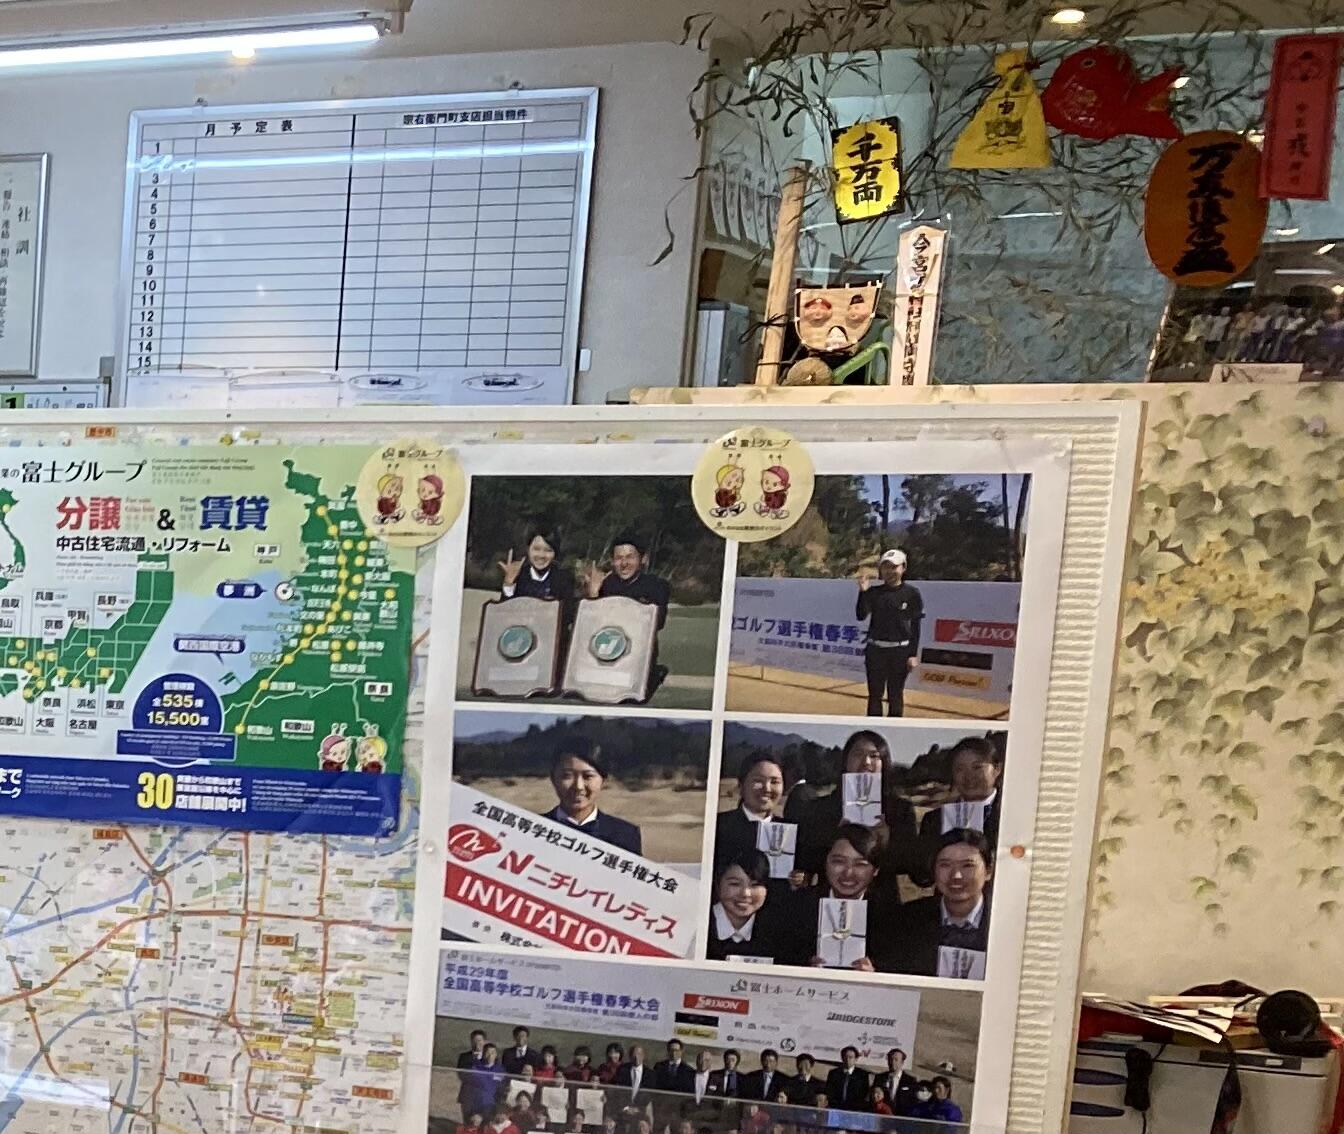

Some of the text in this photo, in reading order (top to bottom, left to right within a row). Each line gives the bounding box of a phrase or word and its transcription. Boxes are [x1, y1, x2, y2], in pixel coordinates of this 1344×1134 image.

[846, 127, 886, 205] 千万両
[21, 459, 148, 484] 富士グループ
[56, 494, 270, 532] 分譲 & 賃貸
[56, 535, 146, 553] 中古住宅流通
[44, 618, 64, 630] 京都
[105, 699, 125, 711] 東京
[35, 717, 55, 728] 大阪
[69, 719, 97, 730] 名古屋
[137, 772, 175, 809] 30
[470, 799, 680, 895] 全国高等学校ゴルフ選手権大会
[455, 873, 633, 956] INVITATION
[526, 862, 678, 940] ニチレイレディス
[442, 976, 660, 1012] 全国高等学校ゴルフ選手権春季大会
[826, 1011, 897, 1028] BRIDGESTONE
